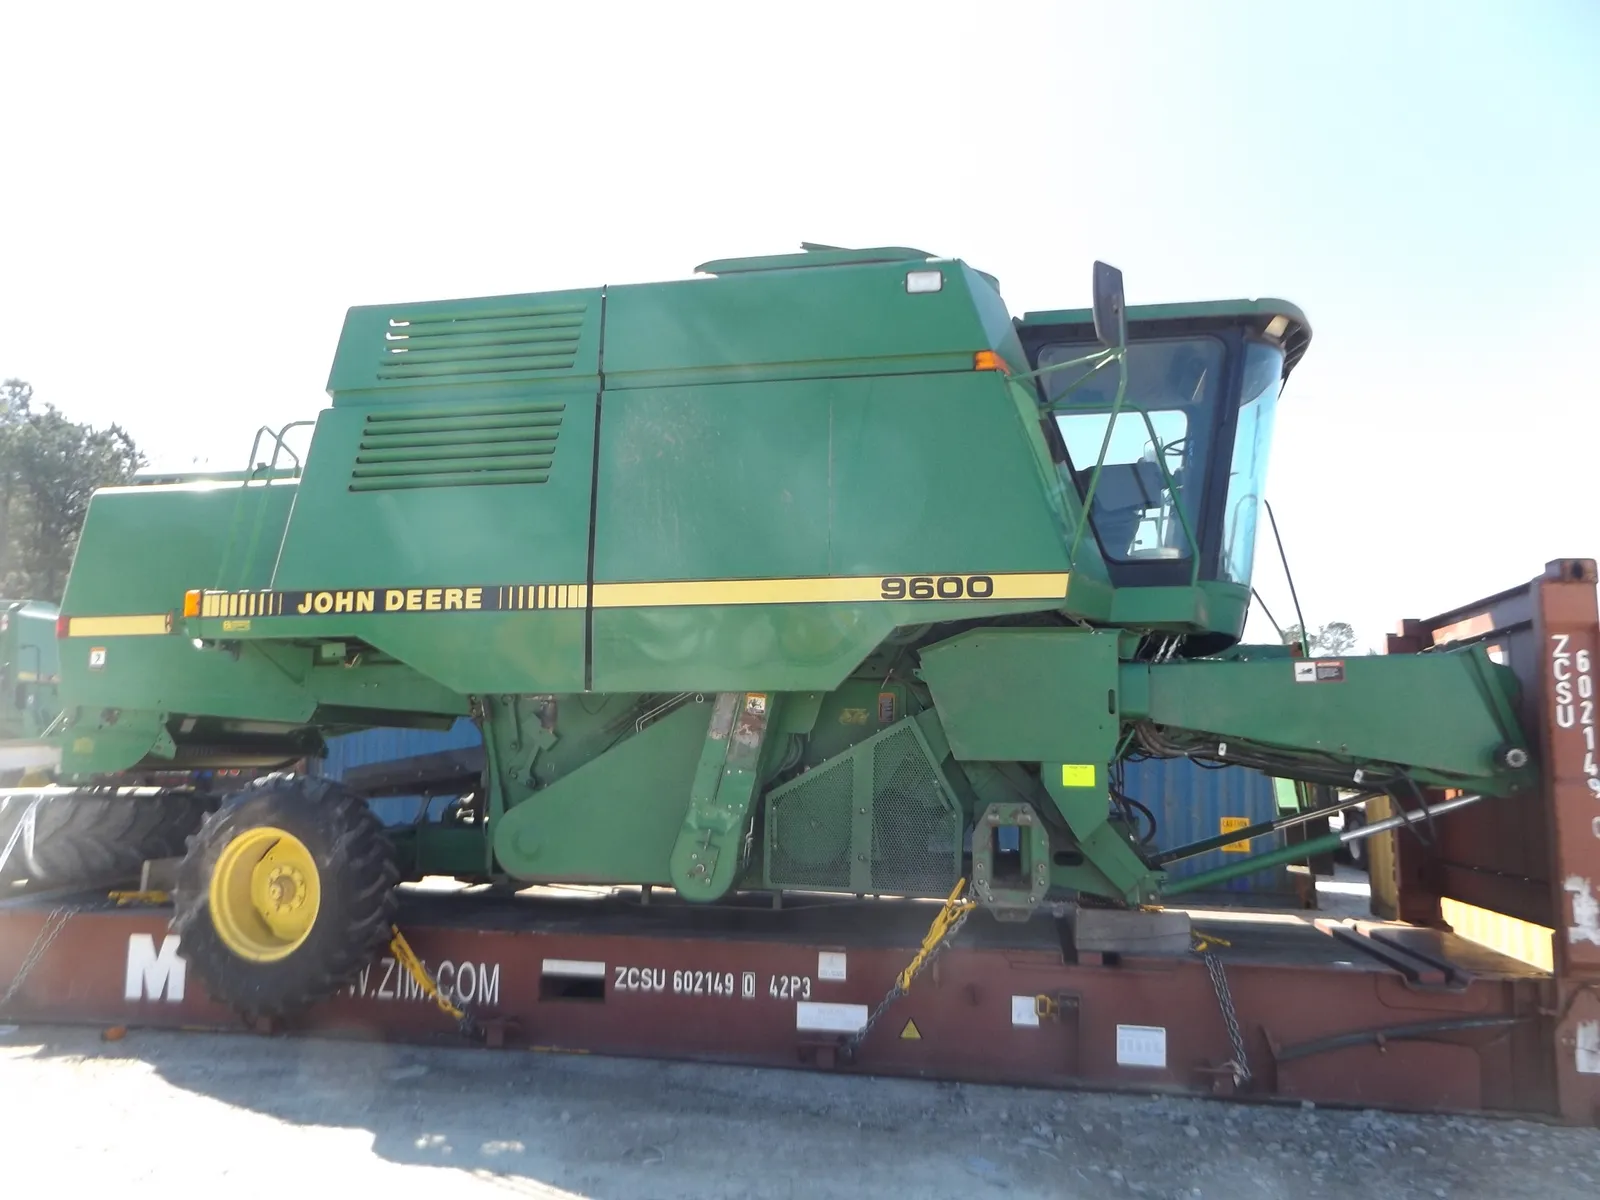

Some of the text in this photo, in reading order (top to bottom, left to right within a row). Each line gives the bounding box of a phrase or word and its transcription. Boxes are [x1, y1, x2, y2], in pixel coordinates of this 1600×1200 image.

[297, 587, 483, 614] JOHN DEERE
[880, 575, 994, 600] 9600
[1551, 634, 1576, 728] ZCSU
[614, 966, 666, 990] ZCSU
[673, 970, 734, 995] 602149
[769, 975, 811, 998] 42P3
